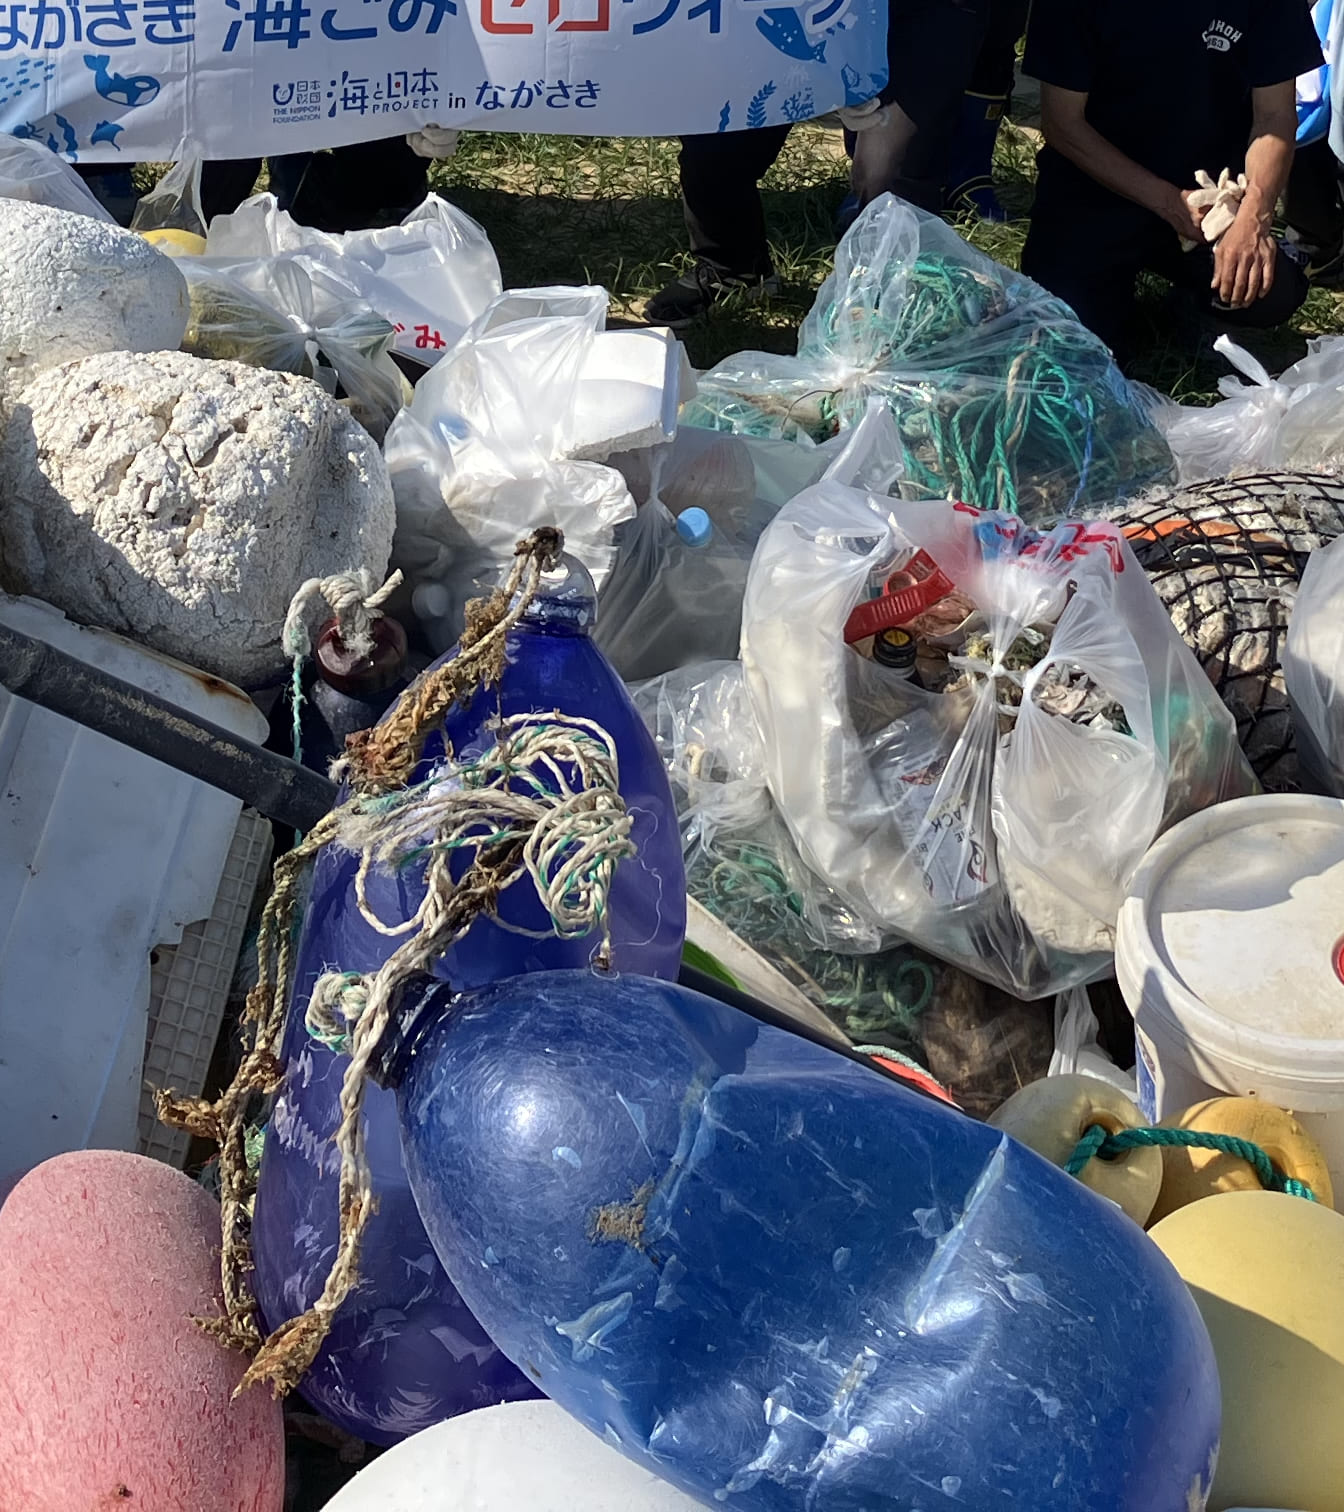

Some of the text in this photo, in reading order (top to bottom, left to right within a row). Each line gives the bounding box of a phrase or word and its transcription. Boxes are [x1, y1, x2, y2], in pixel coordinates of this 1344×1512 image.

[372, 97, 440, 114] PROJECT
[447, 79, 601, 112] in ながさき
